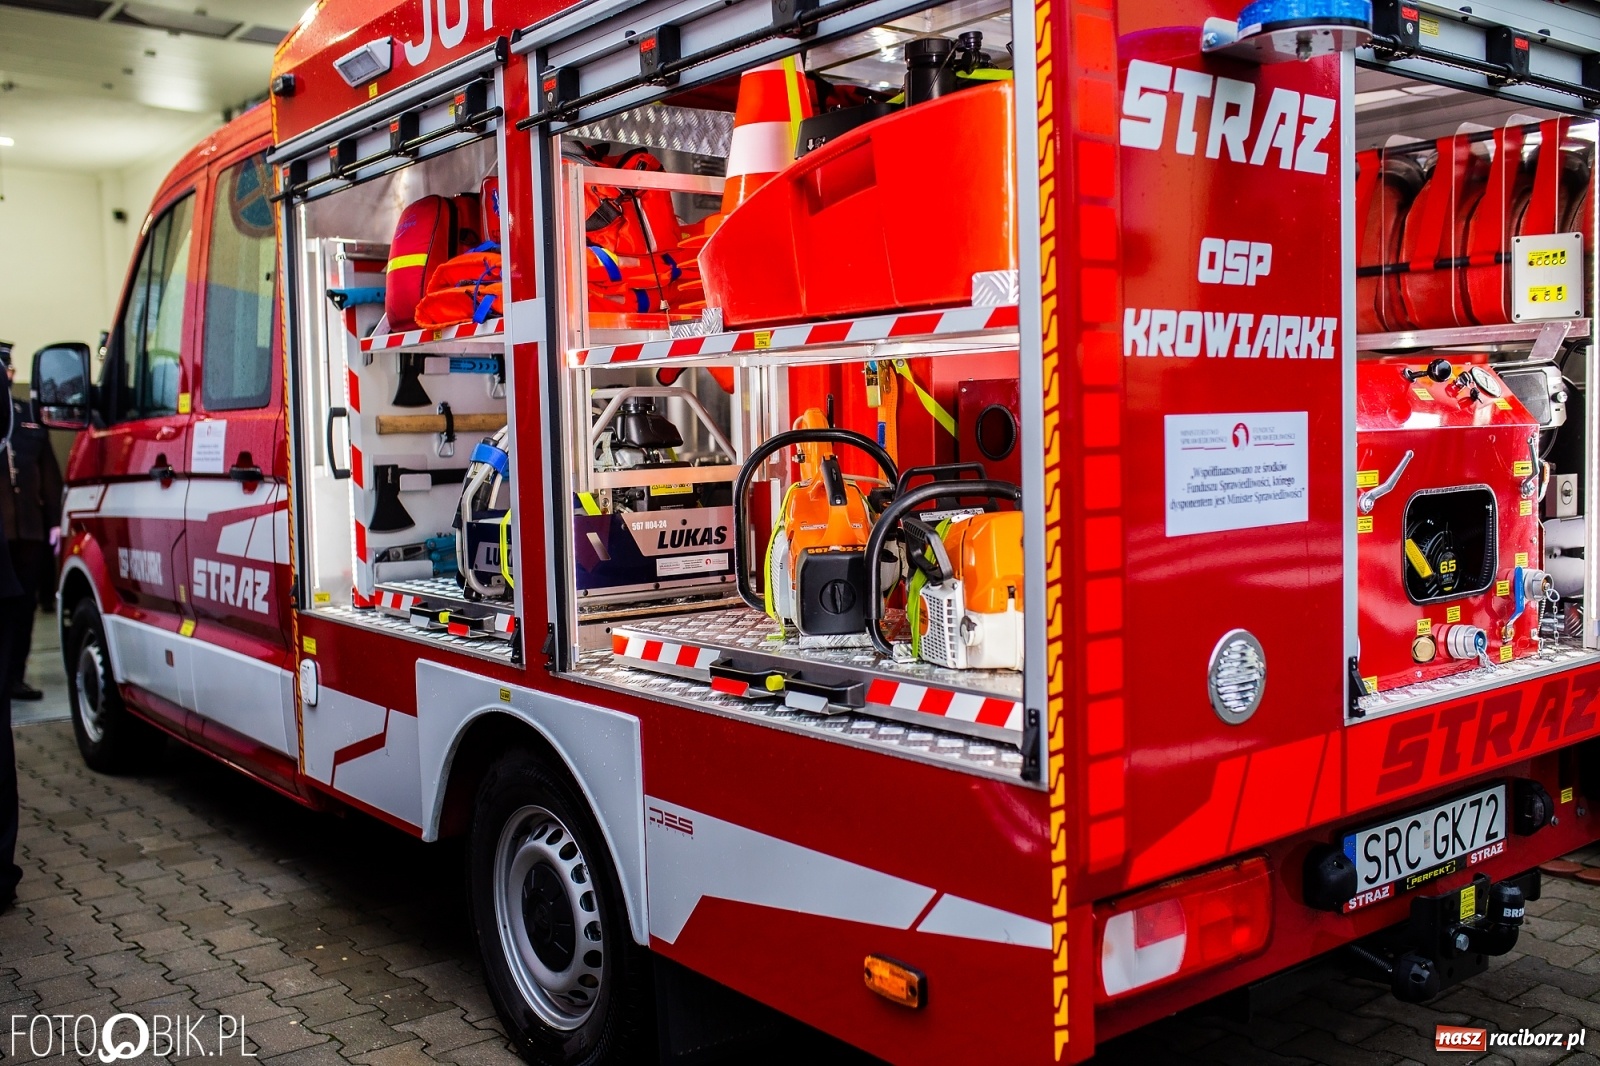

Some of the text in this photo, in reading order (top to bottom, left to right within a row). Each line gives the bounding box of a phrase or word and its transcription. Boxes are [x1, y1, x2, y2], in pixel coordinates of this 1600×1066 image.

[1197, 237, 1273, 286] OSP
[1123, 307, 1338, 360] KROWIARKI
[657, 525, 728, 550] LUKAS
[1363, 793, 1499, 885] SRC GK72
[1411, 864, 1451, 886] PERFEKT
